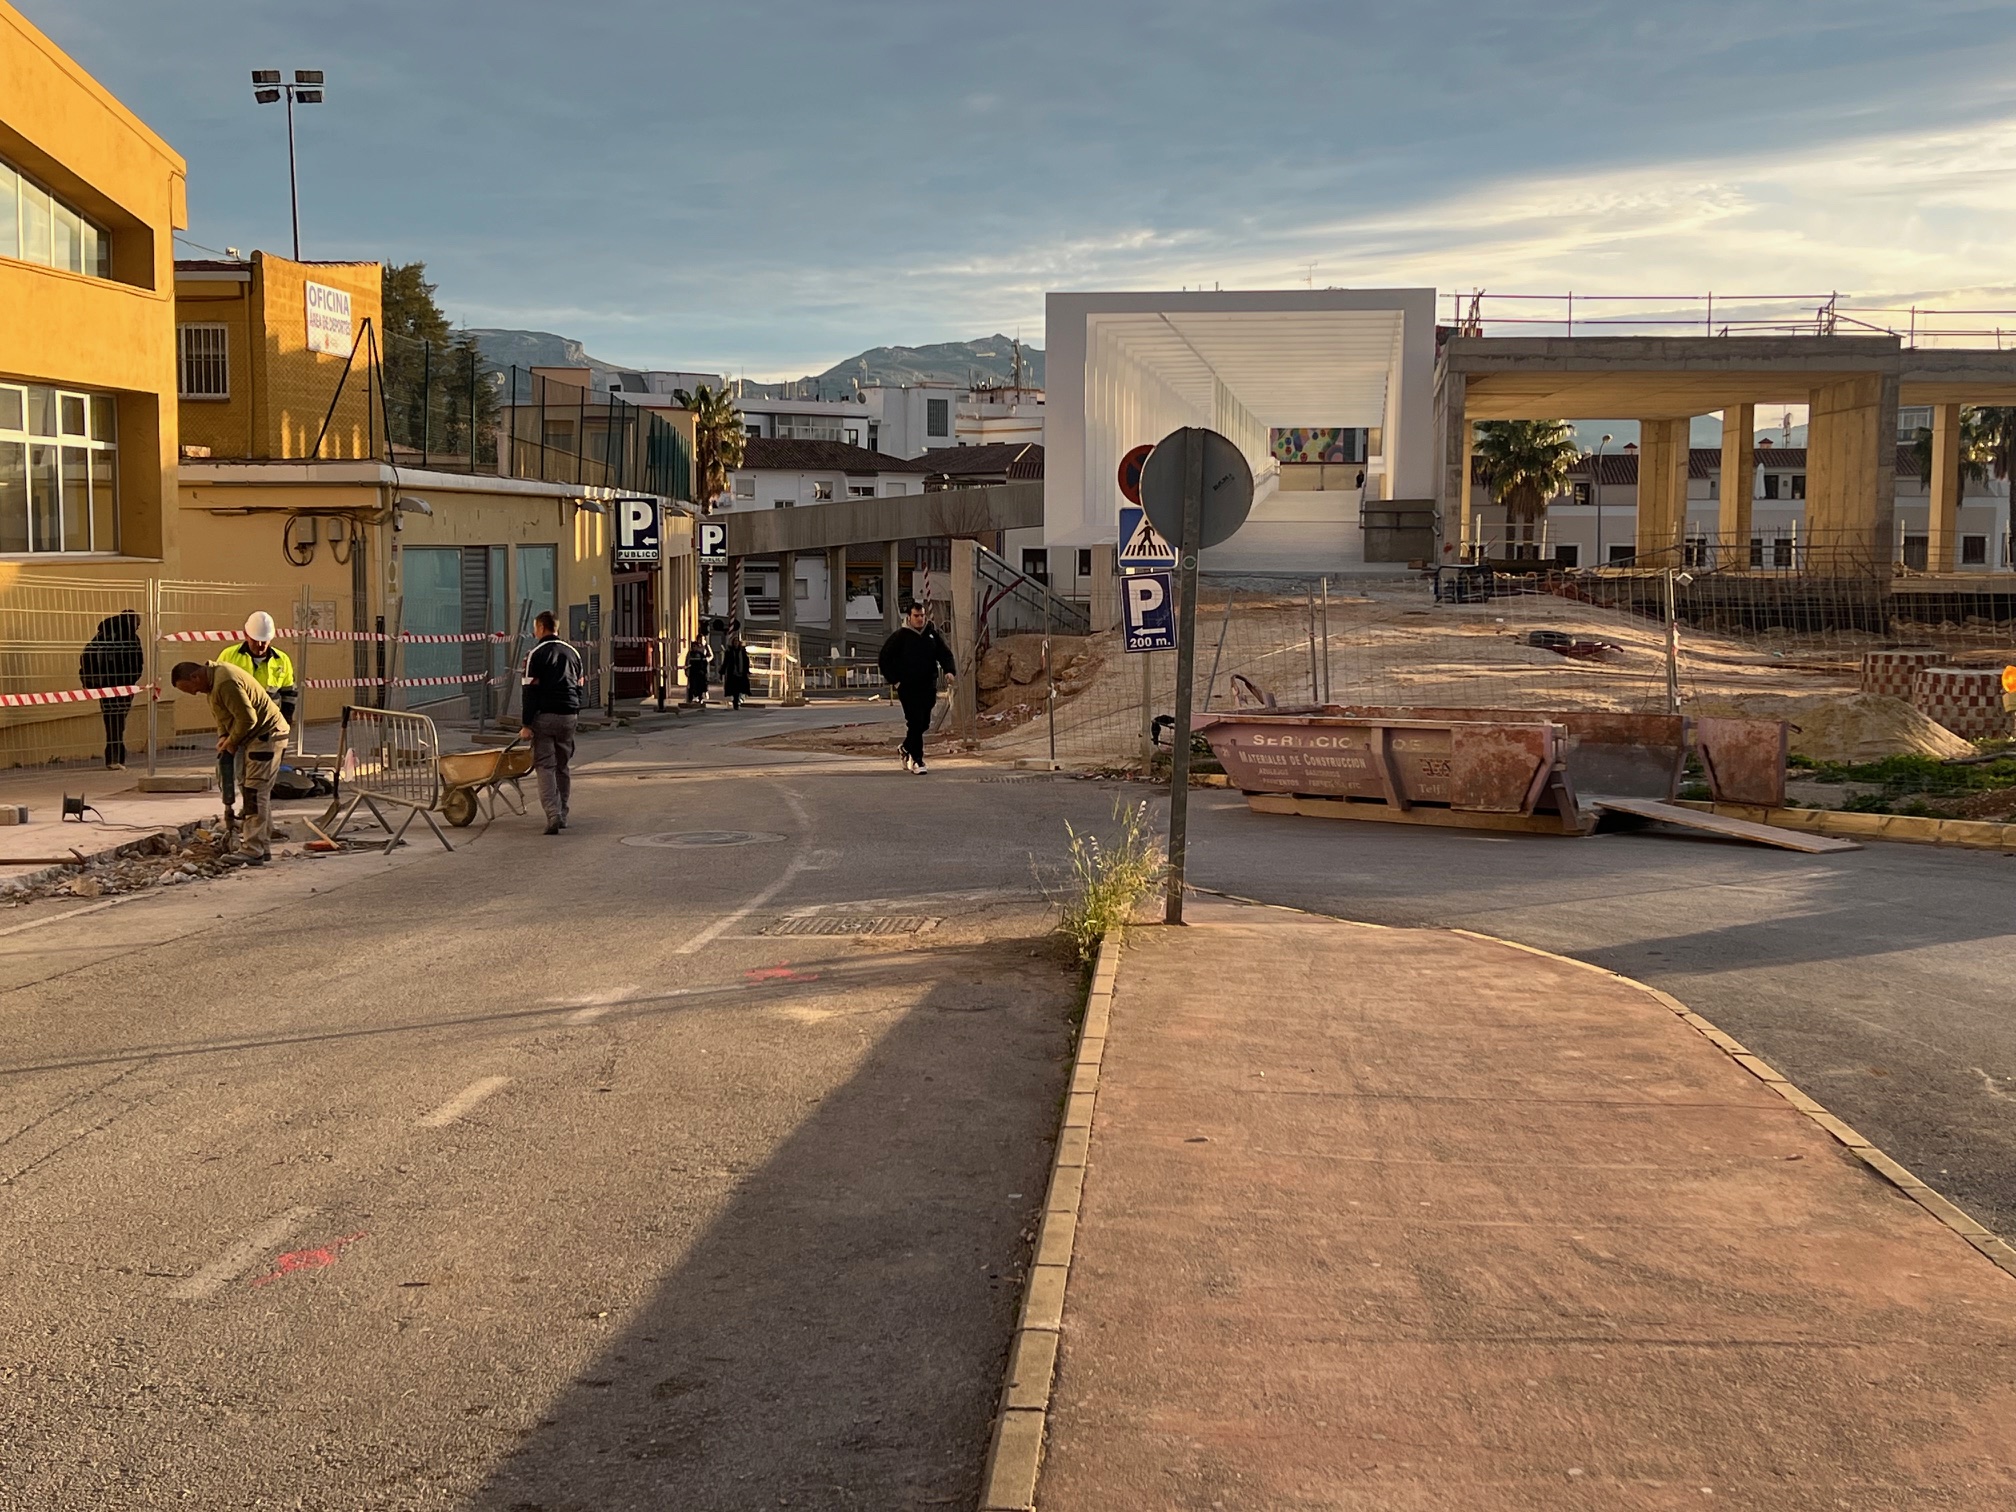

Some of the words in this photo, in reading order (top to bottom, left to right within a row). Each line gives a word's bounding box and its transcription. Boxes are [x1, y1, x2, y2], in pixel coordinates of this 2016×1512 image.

[309, 285, 350, 316] OFICINA
[620, 501, 653, 546] P
[618, 550, 657, 558] PUBLICO
[701, 525, 723, 554] P
[1128, 578, 1164, 627] P
[1130, 637, 1152, 648] 200
[1156, 637, 1171, 646] m.
[1239, 751, 1287, 765] MATERIALES
[1290, 755, 1302, 766] DE
[1303, 753, 1367, 769] CONSTRUCCION
